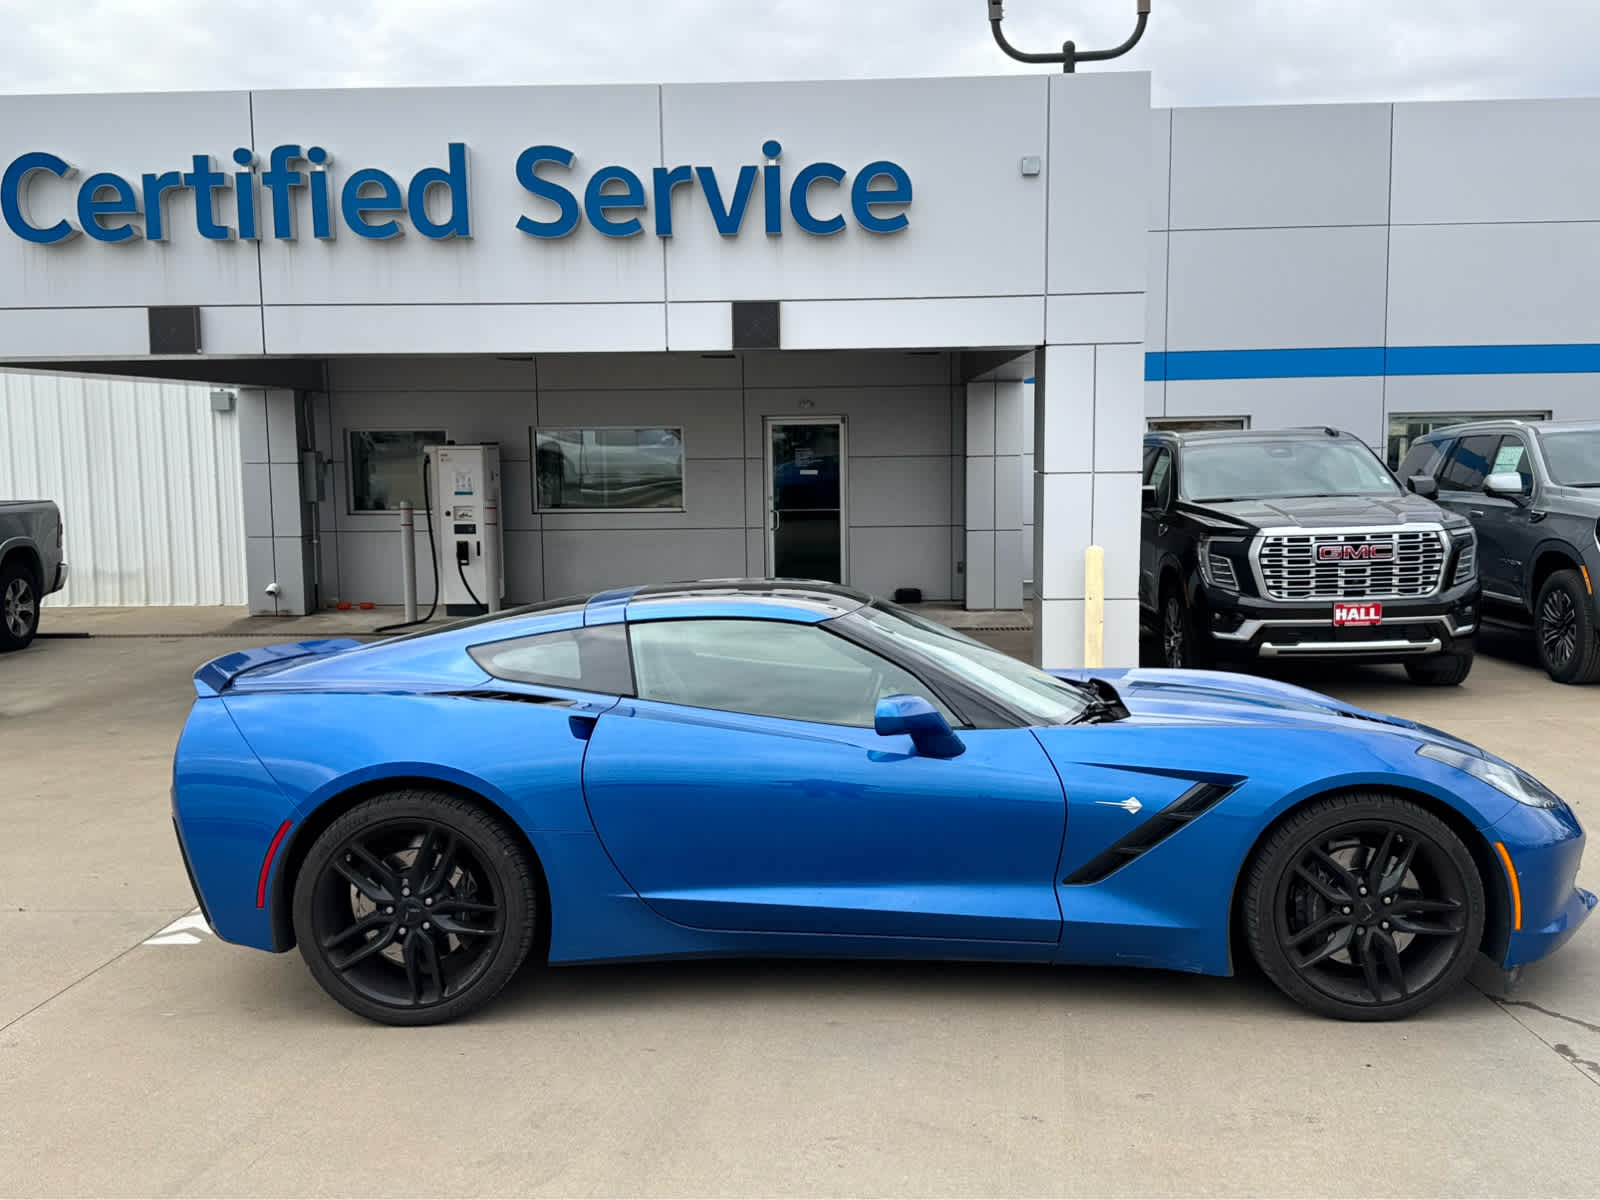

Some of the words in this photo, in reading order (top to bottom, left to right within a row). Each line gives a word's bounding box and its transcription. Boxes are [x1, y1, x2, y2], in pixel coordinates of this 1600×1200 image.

[0, 142, 472, 243] Certified
[515, 140, 914, 238] Service
[1319, 544, 1393, 560] GMC
[1335, 607, 1380, 620] HALL
